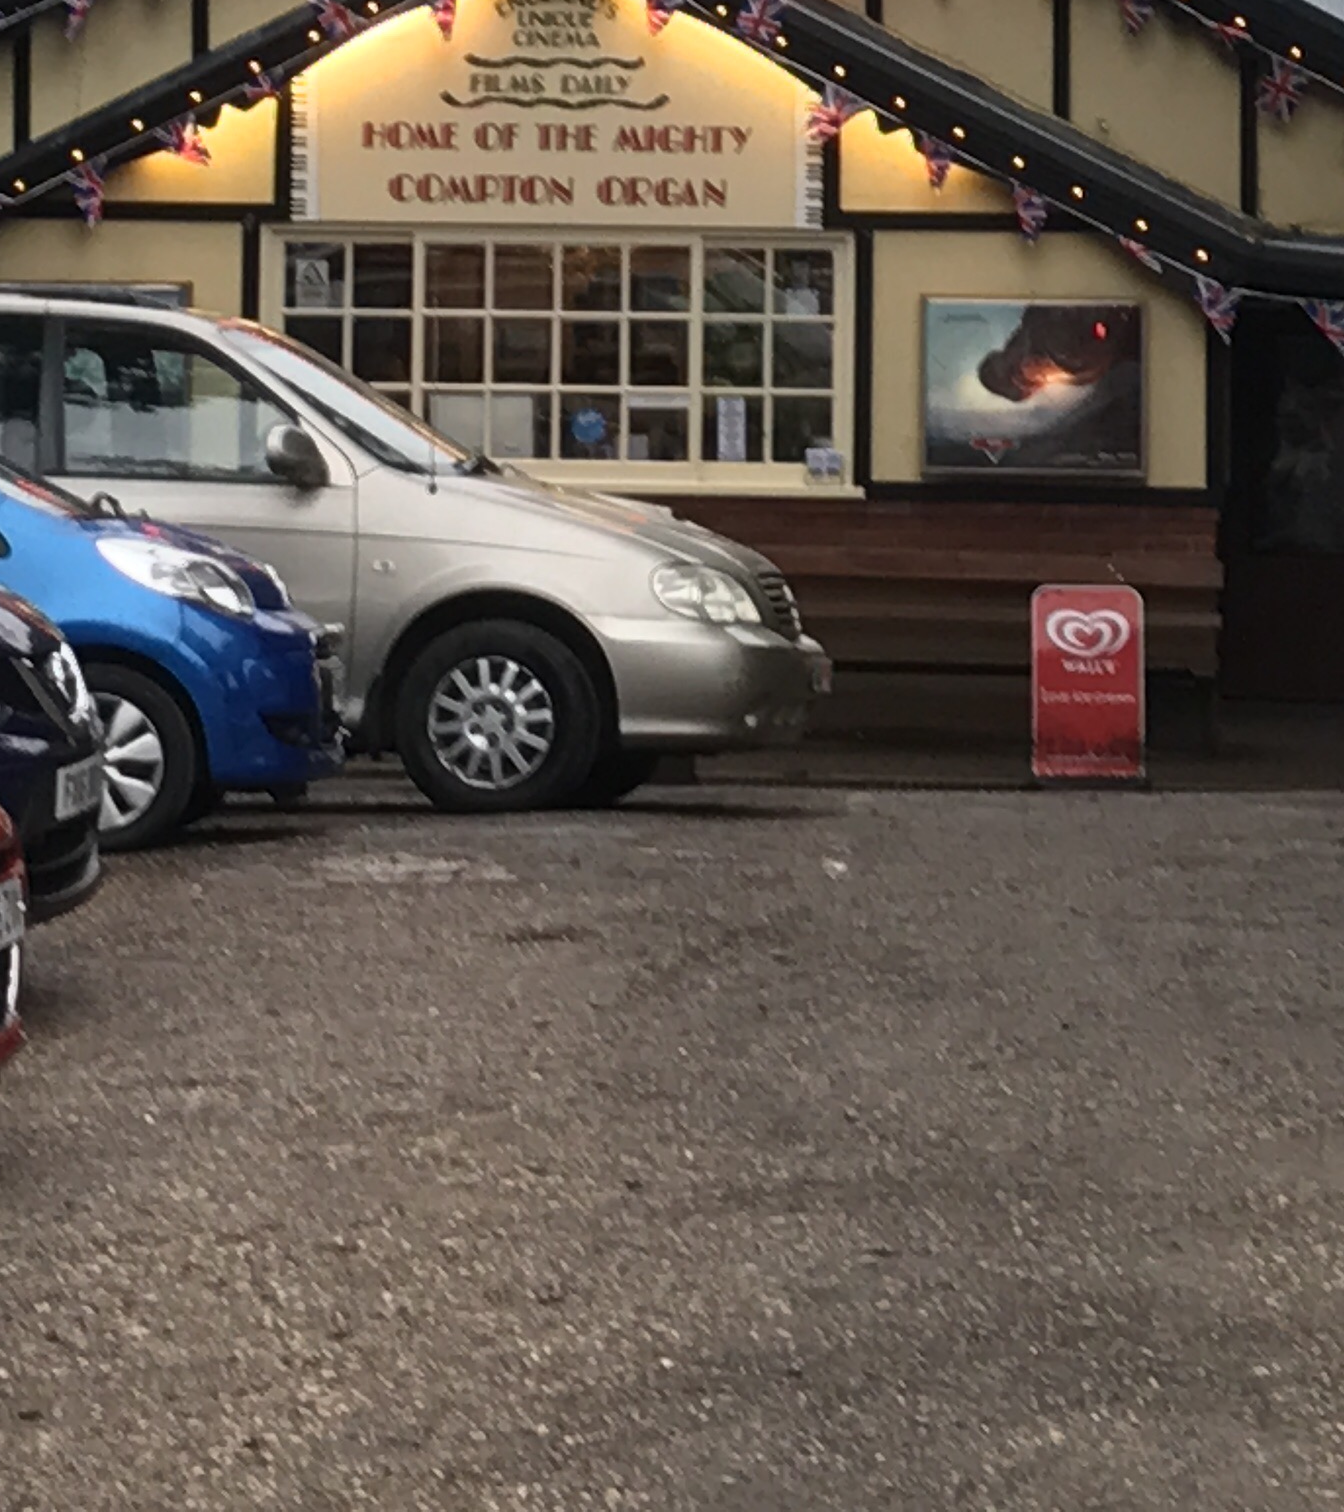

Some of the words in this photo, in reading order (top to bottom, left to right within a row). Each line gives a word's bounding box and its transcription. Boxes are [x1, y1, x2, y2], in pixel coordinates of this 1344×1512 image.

[517, 10, 594, 28] UNIQUE
[512, 29, 601, 48] CINEMA
[469, 72, 546, 95] FILMS
[560, 72, 632, 95] DAILY
[361, 120, 460, 151] HOME
[473, 121, 520, 151] OF
[535, 122, 599, 152] THE
[611, 124, 753, 155] MIGHTY
[387, 172, 575, 206] COMPTON
[596, 174, 728, 208] ORGAN
